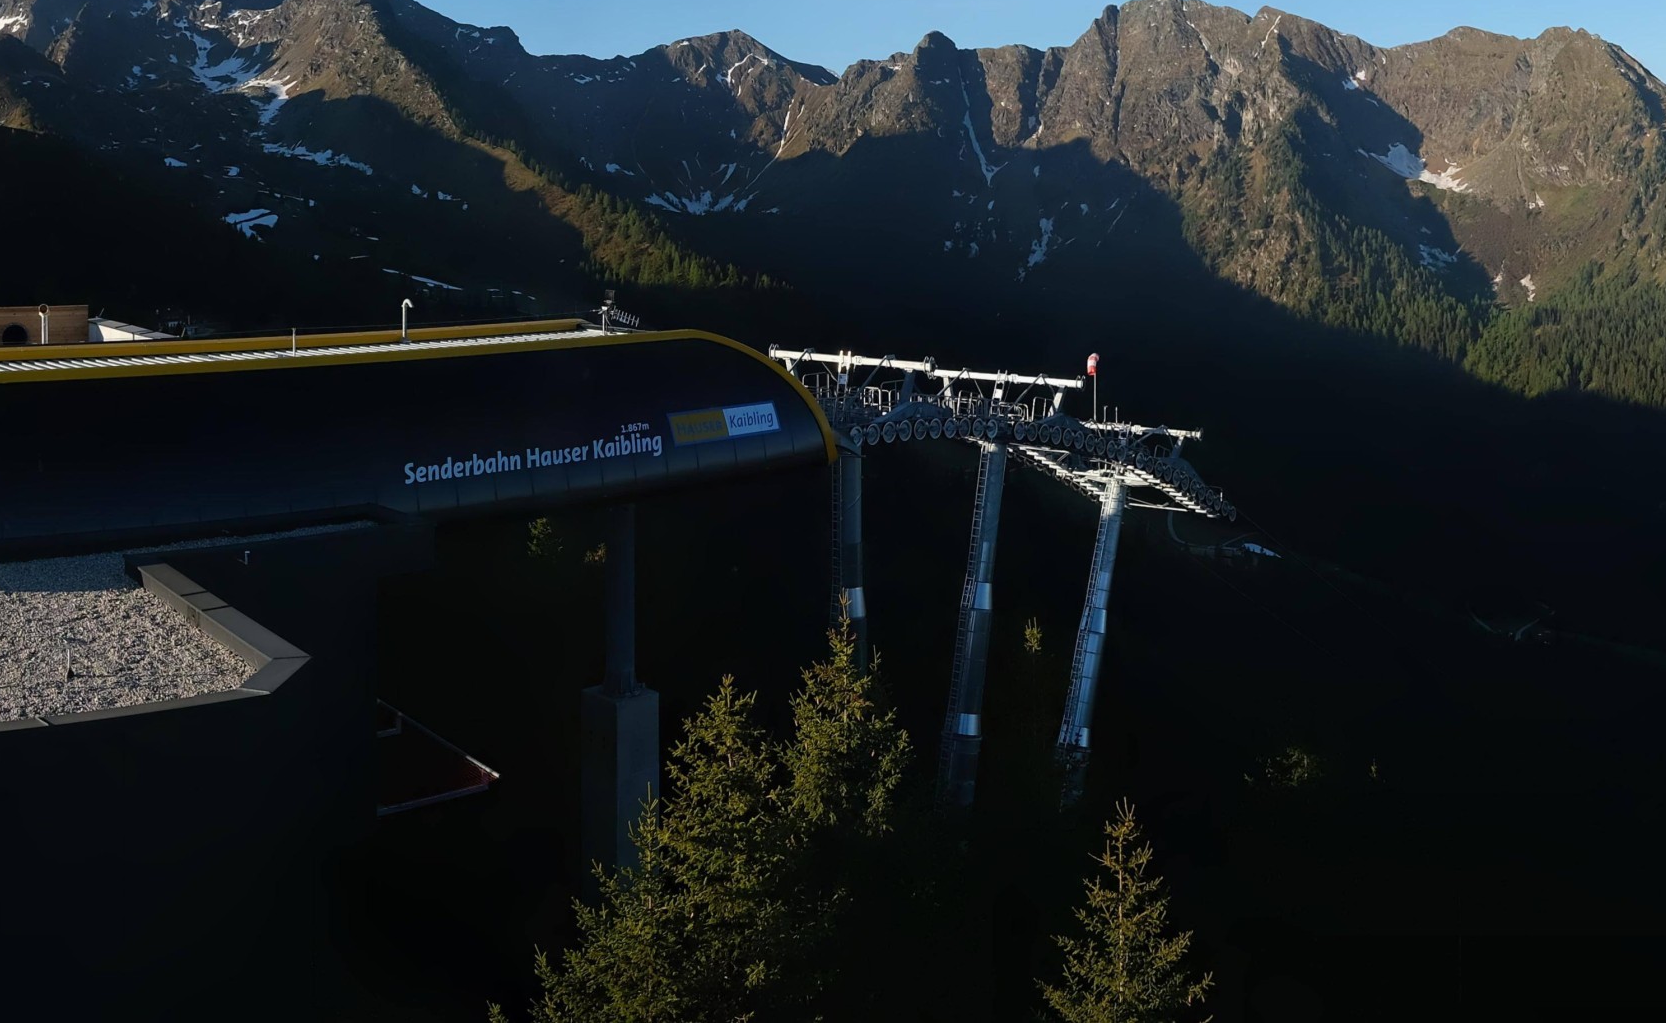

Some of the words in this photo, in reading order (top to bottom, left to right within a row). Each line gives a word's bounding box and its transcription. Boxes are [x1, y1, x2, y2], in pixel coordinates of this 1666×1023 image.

[729, 411, 774, 428] Kaibling
[404, 450, 521, 485] Senderbahn
[526, 445, 589, 468] Hauser
[592, 432, 663, 459] Kaibling
